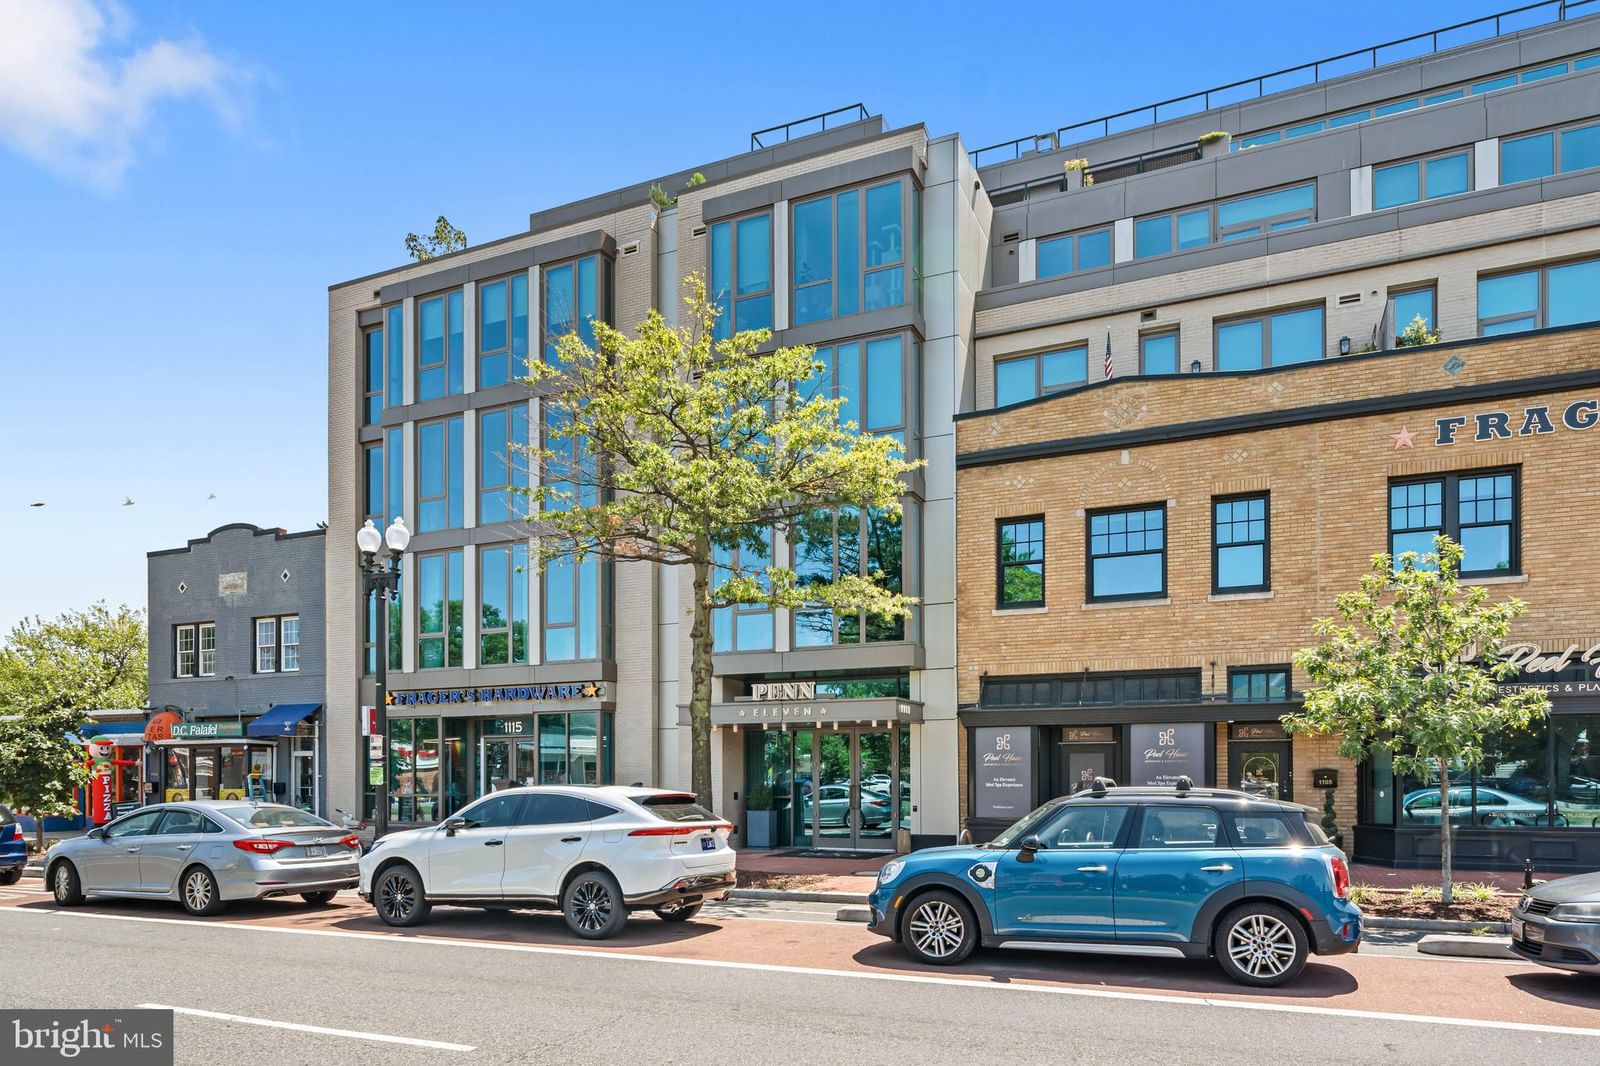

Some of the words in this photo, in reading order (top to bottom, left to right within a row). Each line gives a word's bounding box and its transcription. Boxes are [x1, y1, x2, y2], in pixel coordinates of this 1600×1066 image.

[1435, 400, 1600, 446] FRAG
[1497, 643, 1579, 681] Peel
[396, 689, 476, 705] FRAGER'S
[480, 685, 582, 703] HARDWARE
[751, 681, 816, 700] PENN
[1495, 684, 1560, 694] ESTHTICS
[1565, 684, 1573, 692] &
[753, 706, 813, 717] ELEVEN
[173, 725, 189, 736] D.C.
[189, 723, 218, 736] Falafel
[504, 721, 523, 733] 1115
[102, 775, 113, 821] PIZZA
